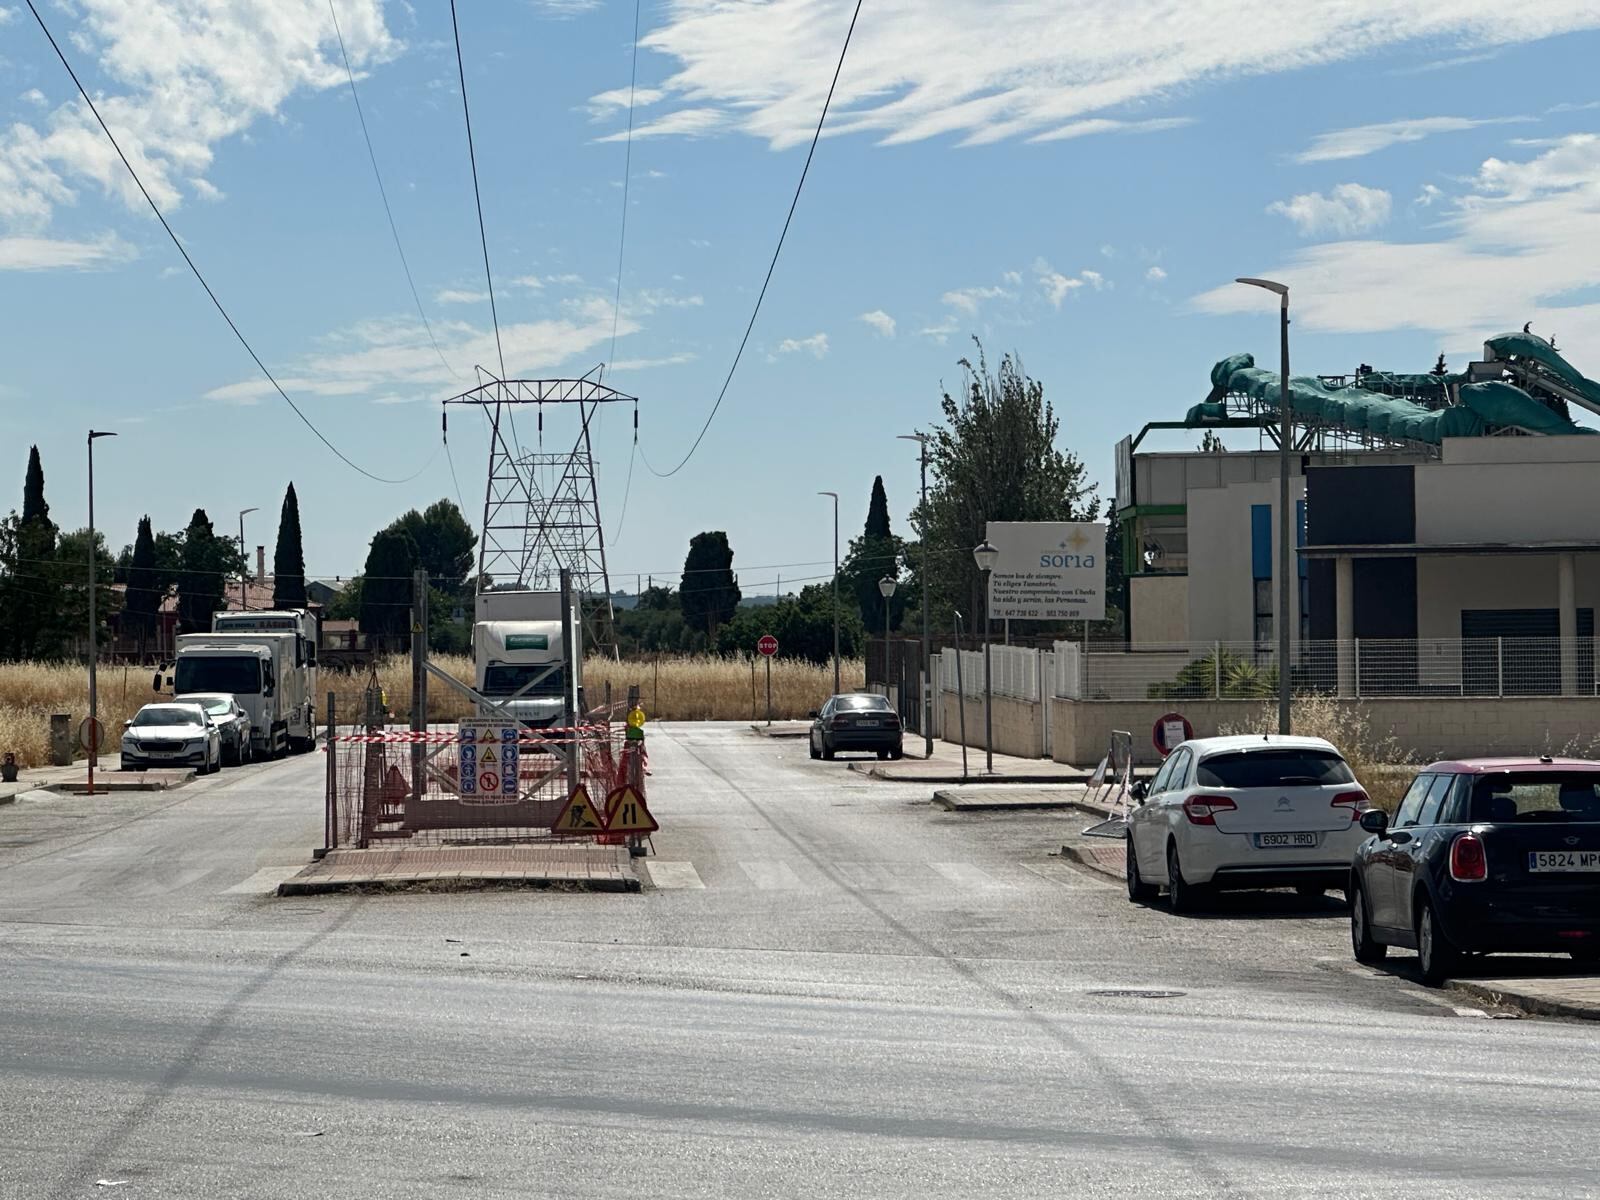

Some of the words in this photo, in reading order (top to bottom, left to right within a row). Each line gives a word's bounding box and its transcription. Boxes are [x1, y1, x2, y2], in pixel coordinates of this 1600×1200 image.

[1040, 555, 1094, 568] soria
[1264, 835, 1288, 845] 6902
[1294, 834, 1312, 844] HRD
[1539, 854, 1575, 867] 5824
[1580, 854, 1600, 867] MP
